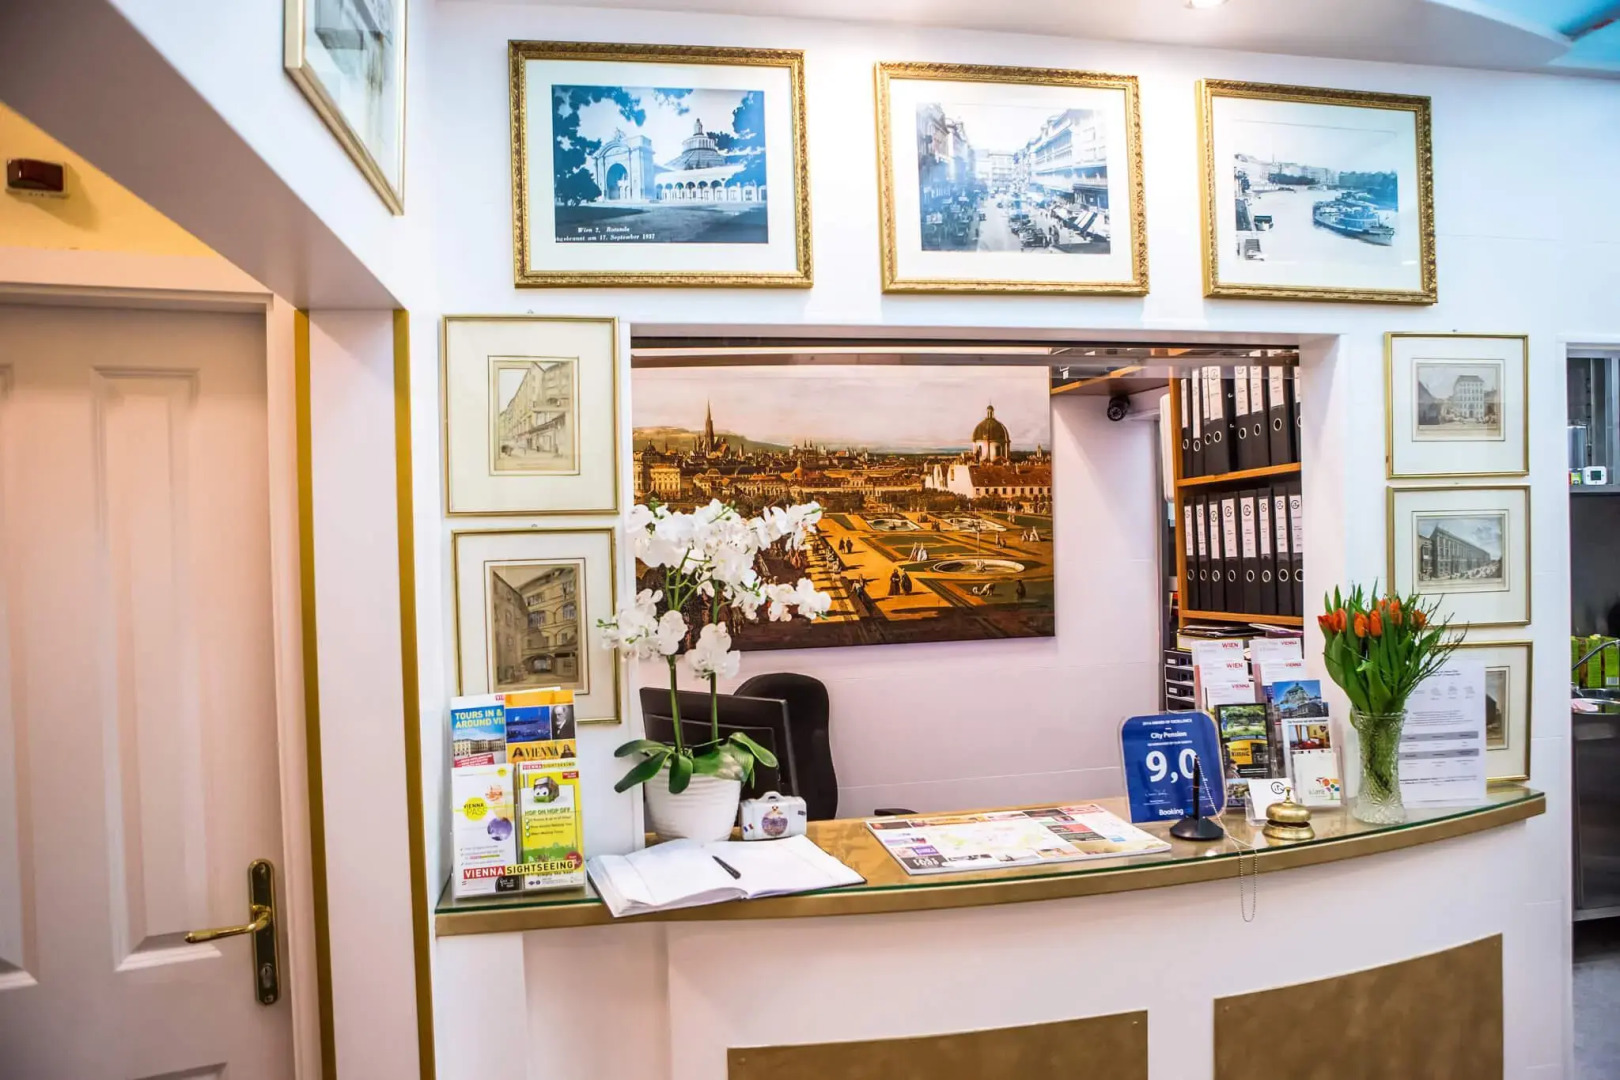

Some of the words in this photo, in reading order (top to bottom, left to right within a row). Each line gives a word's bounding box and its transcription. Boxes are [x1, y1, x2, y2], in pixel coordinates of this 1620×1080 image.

[610, 233, 640, 241] September
[455, 711, 483, 720] TOURS
[485, 709, 495, 717] IN
[496, 708, 503, 717] &
[455, 718, 492, 729] AROUND
[1150, 732, 1163, 740] City
[1163, 730, 1188, 738] Pension
[525, 746, 559, 757] VIENNA
[1145, 748, 1198, 783] 9,0
[463, 802, 485, 810] VIENNA
[464, 867, 504, 878] VIENNA
[506, 860, 574, 875] SIGHTSEEING
